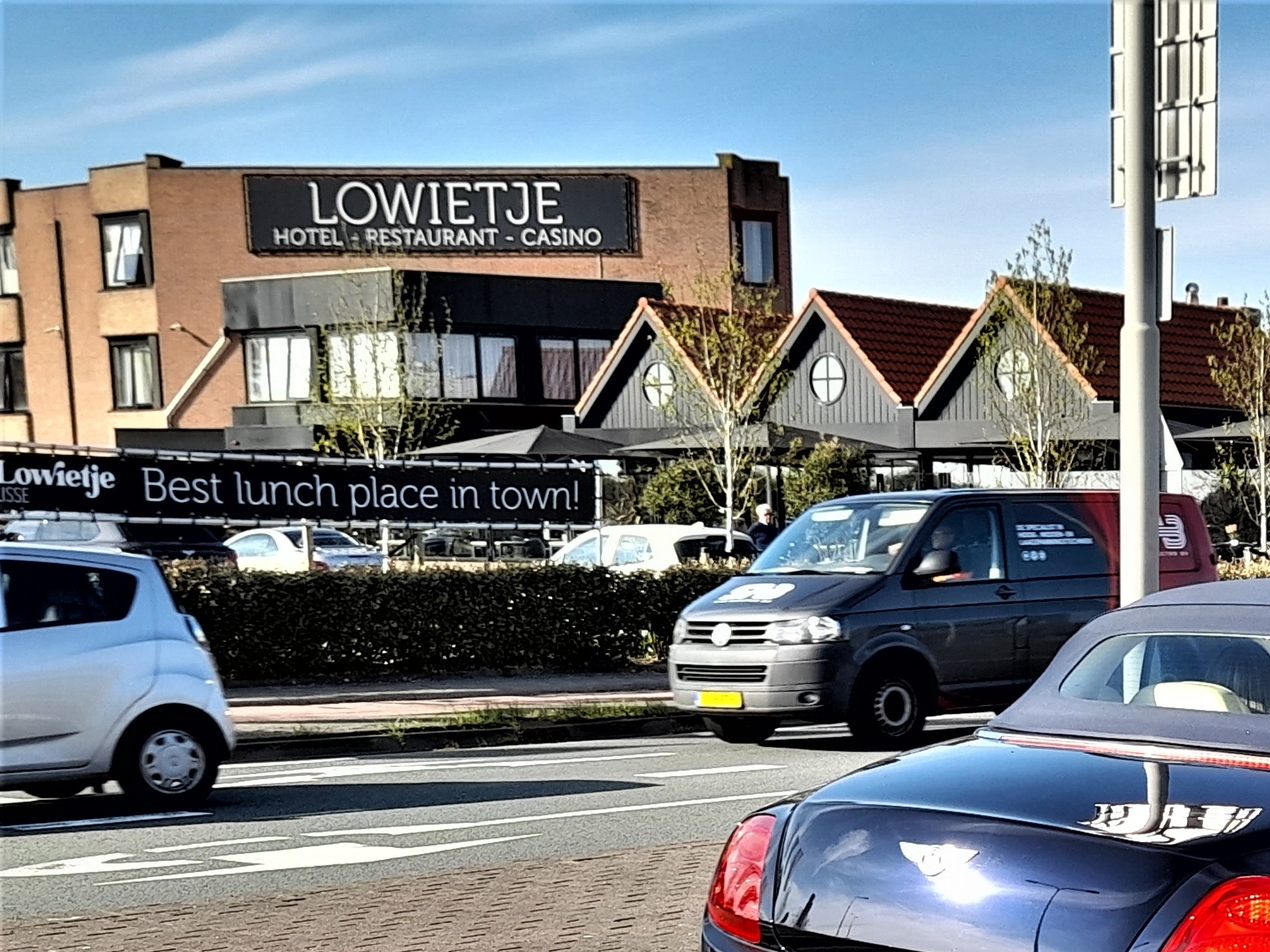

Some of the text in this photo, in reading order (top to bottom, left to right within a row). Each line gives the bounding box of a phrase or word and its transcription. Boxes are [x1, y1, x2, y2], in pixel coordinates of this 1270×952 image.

[307, 180, 564, 226] LOWIETJE
[273, 227, 344, 247] HOTEL
[368, 228, 500, 246] RESTAURANT
[520, 227, 602, 247] CASINO
[0, 459, 116, 499] Lowietje
[140, 466, 579, 516] Best lunch place in town!
